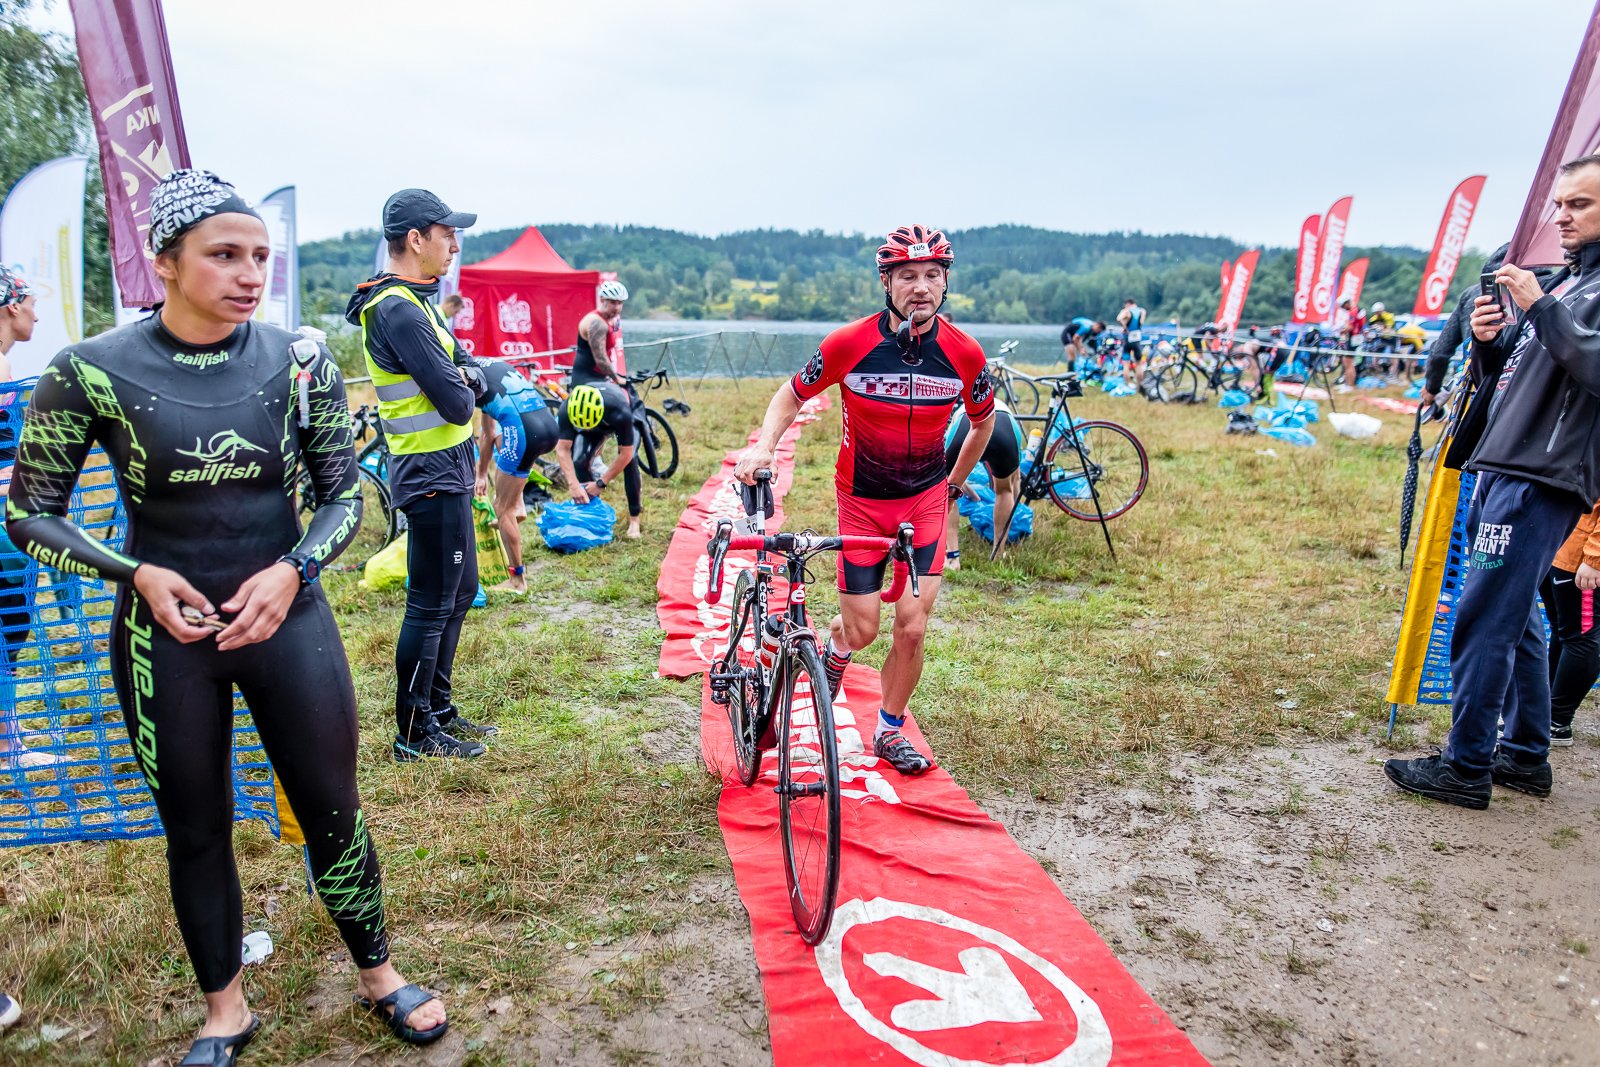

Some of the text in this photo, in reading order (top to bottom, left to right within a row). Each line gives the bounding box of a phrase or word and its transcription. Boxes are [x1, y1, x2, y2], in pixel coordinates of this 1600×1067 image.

[173, 350, 229, 370] sailfish
[168, 461, 261, 486] sailfish
[311, 499, 358, 562] ibrant
[747, 522, 758, 534] 10
[1478, 521, 1513, 540] UPER
[1473, 536, 1509, 556] PRINT
[759, 581, 768, 636] cerv
[125, 597, 160, 790] vibrant
